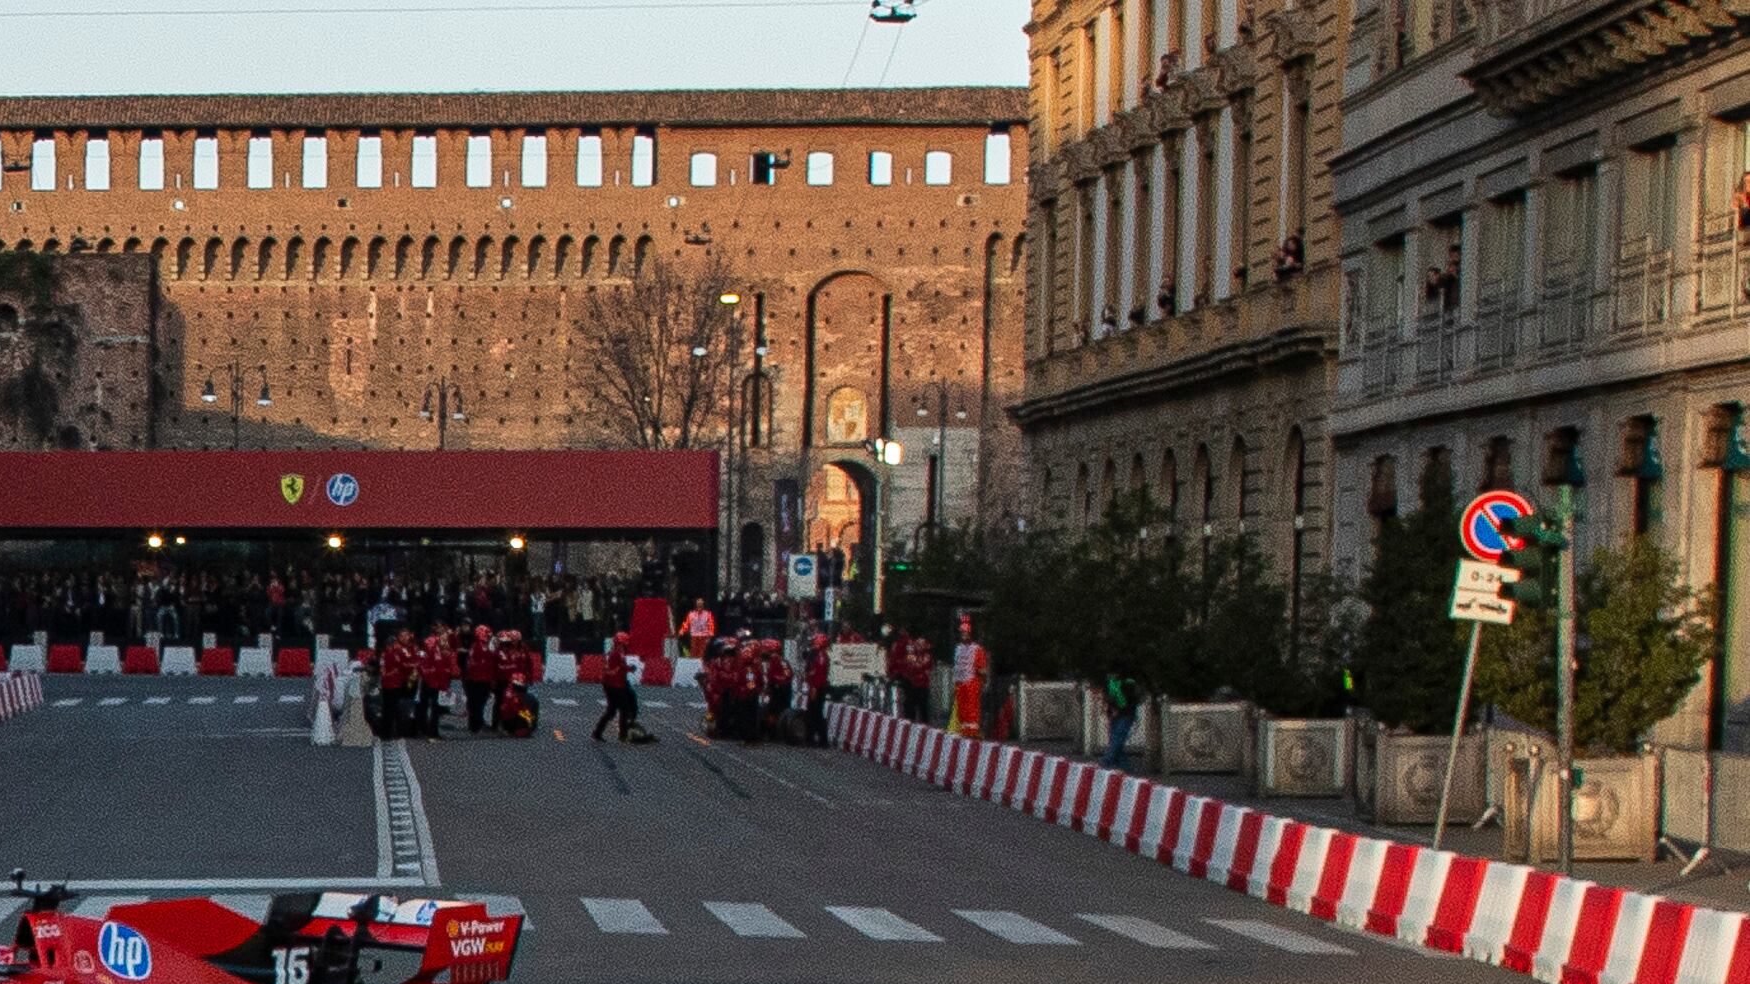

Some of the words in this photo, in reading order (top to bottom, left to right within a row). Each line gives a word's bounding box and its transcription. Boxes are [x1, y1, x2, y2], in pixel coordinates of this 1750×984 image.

[331, 475, 355, 503] hp
[459, 919, 505, 936] V-Power
[107, 922, 143, 977] hp
[450, 936, 486, 960] VGW
